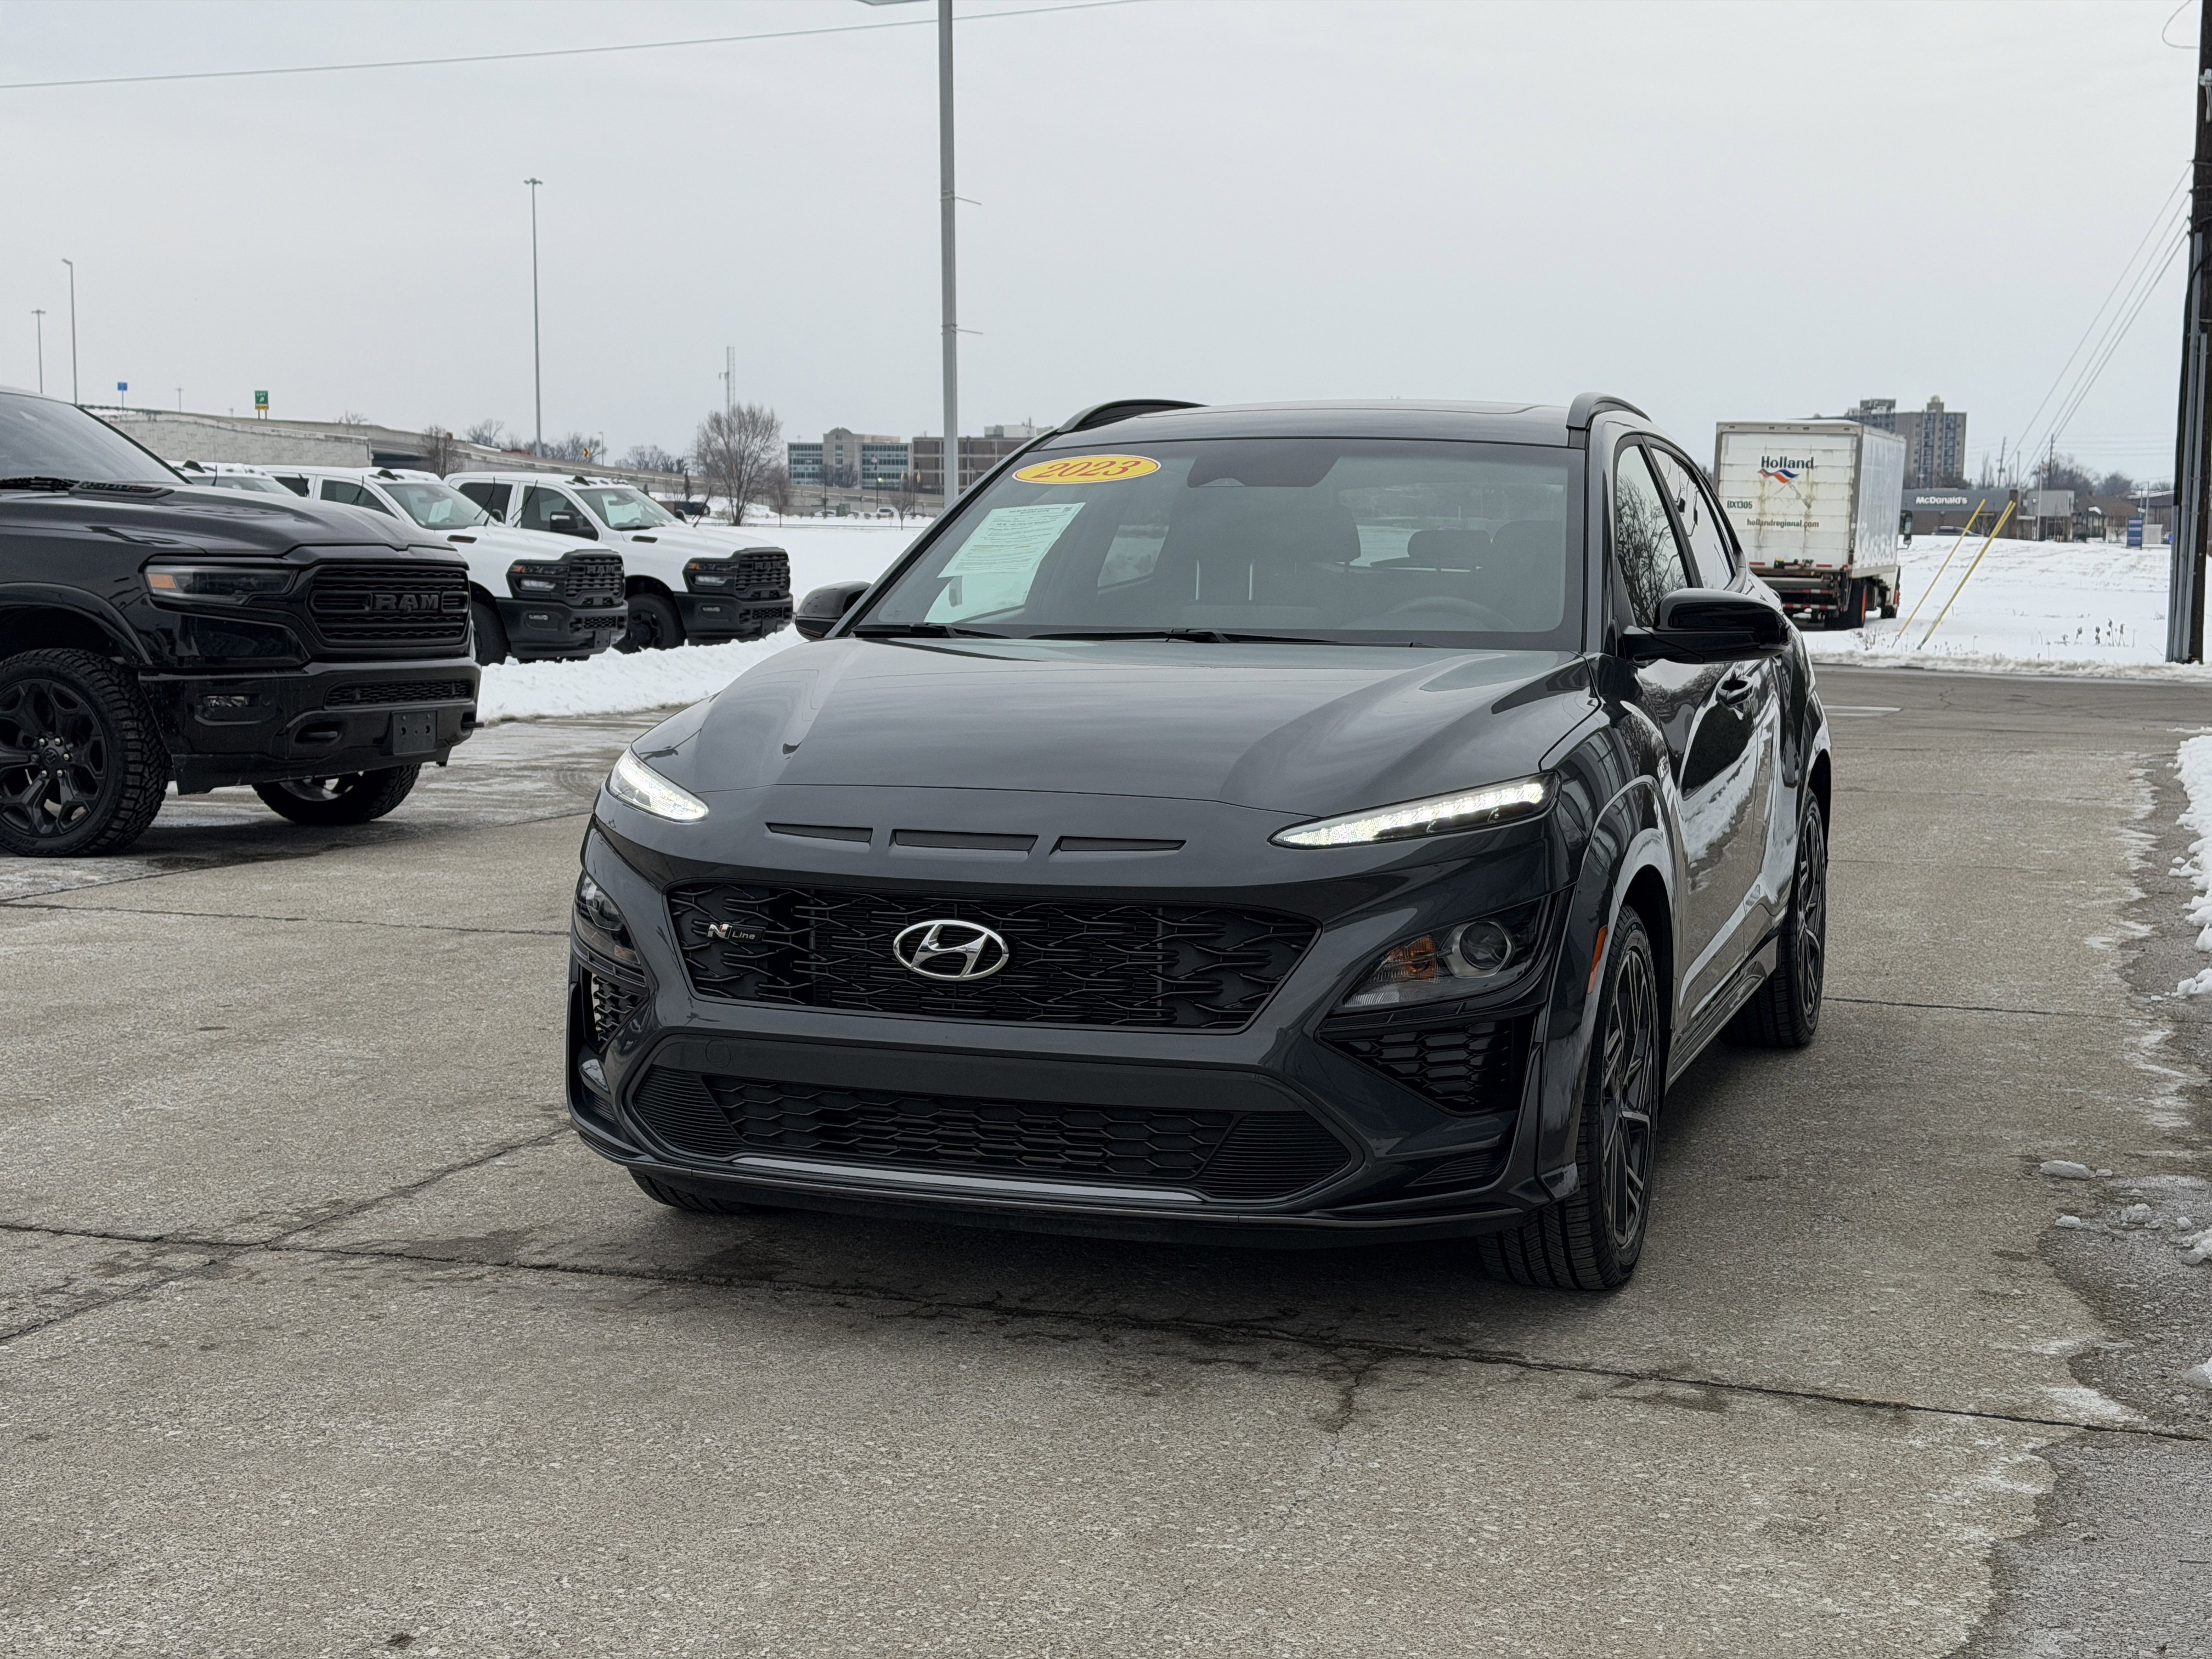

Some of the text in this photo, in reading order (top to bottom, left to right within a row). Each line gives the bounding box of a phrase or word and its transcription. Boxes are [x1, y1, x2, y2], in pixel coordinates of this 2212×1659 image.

[1030, 460, 1142, 479] 2023
[1761, 456, 1814, 470] Holland
[1915, 496, 1968, 505] McDonald's
[375, 594, 439, 610] RAM
[732, 930, 755, 940] Line
